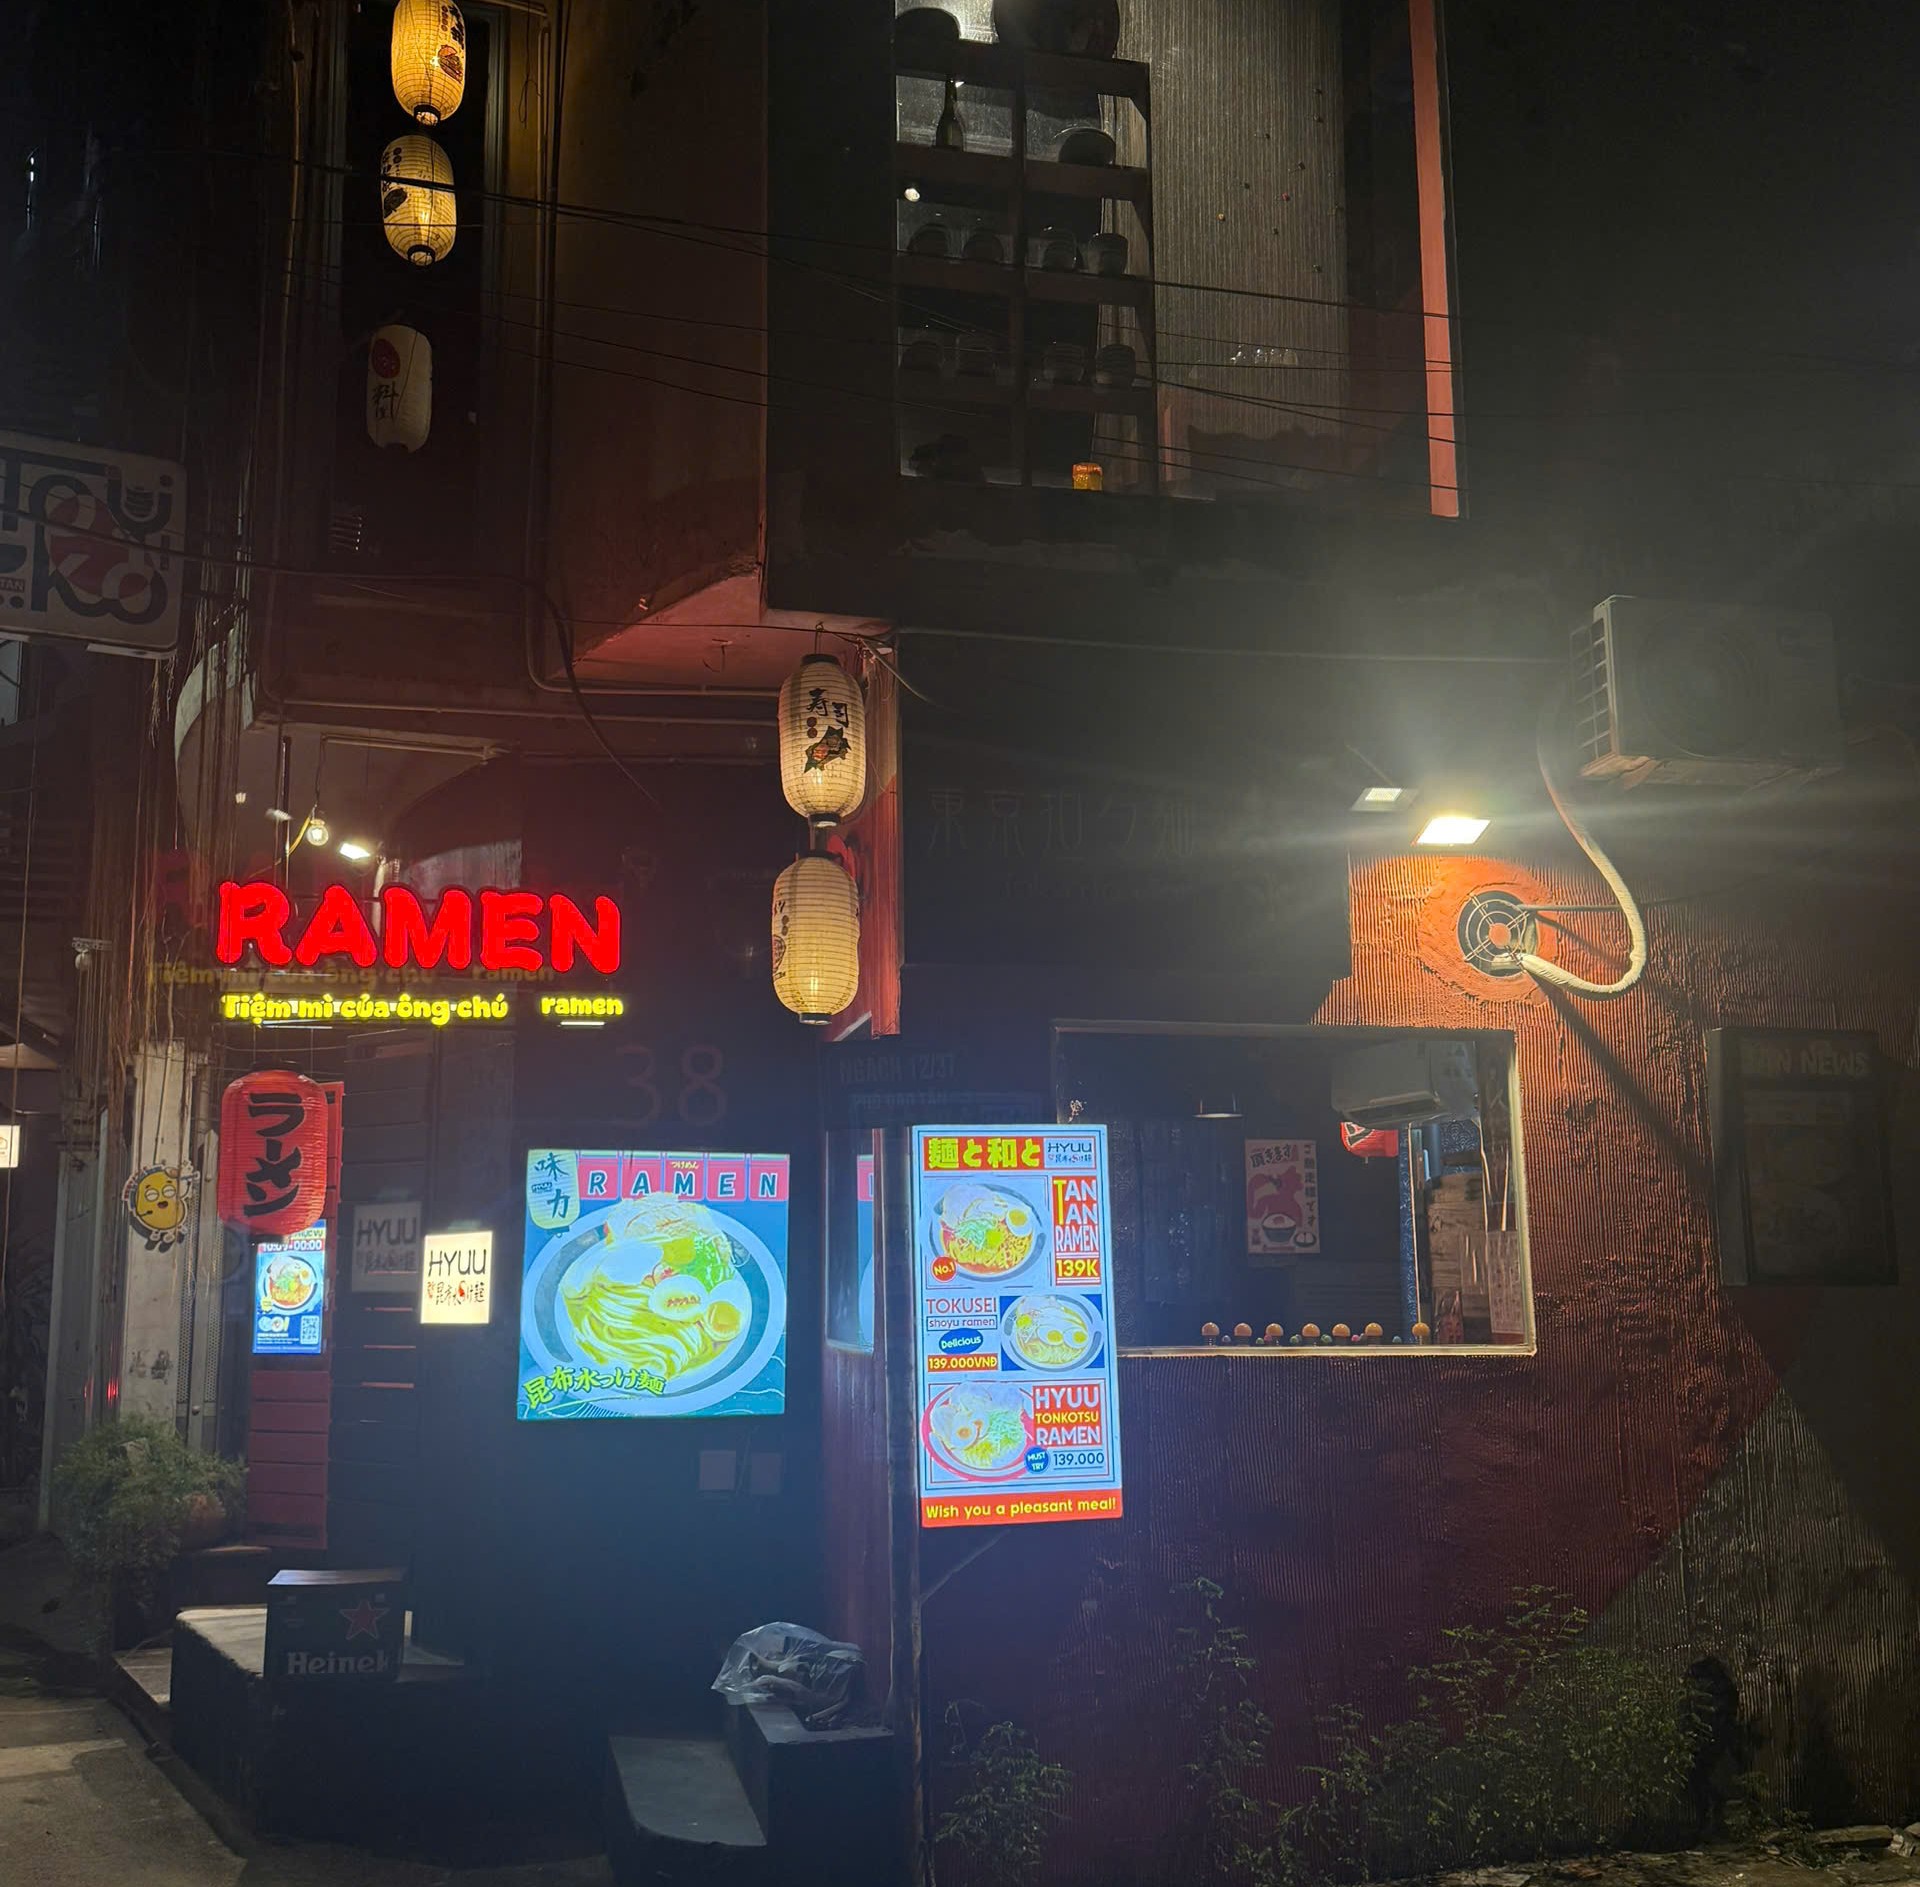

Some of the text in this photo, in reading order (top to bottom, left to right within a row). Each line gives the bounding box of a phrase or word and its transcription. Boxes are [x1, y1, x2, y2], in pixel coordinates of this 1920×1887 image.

[215, 881, 622, 973] RAMEN
[221, 993, 624, 1026] Tiệm mì của ông chú ramen
[243, 1092, 306, 1218] ラーメン
[928, 1137, 1041, 1169] 麺と和と
[1048, 1142, 1093, 1153] HYUU
[587, 1170, 778, 1197] RAMEN
[1056, 1225, 1099, 1251] RAMEN
[428, 1249, 487, 1277] HYUU
[934, 1265, 955, 1276] No.1
[1056, 1259, 1098, 1277] 139K
[926, 1298, 997, 1314] TOKUSEI
[929, 1318, 995, 1328] shoyu ramen
[941, 1336, 981, 1349] Delicious
[1035, 1386, 1099, 1409] HYUU
[1036, 1411, 1099, 1424] TONKOTSU
[1036, 1426, 1101, 1445] RAMEN
[1054, 1453, 1104, 1466] 139.000
[926, 1497, 1116, 1519] Wish you a pleasant meal!
